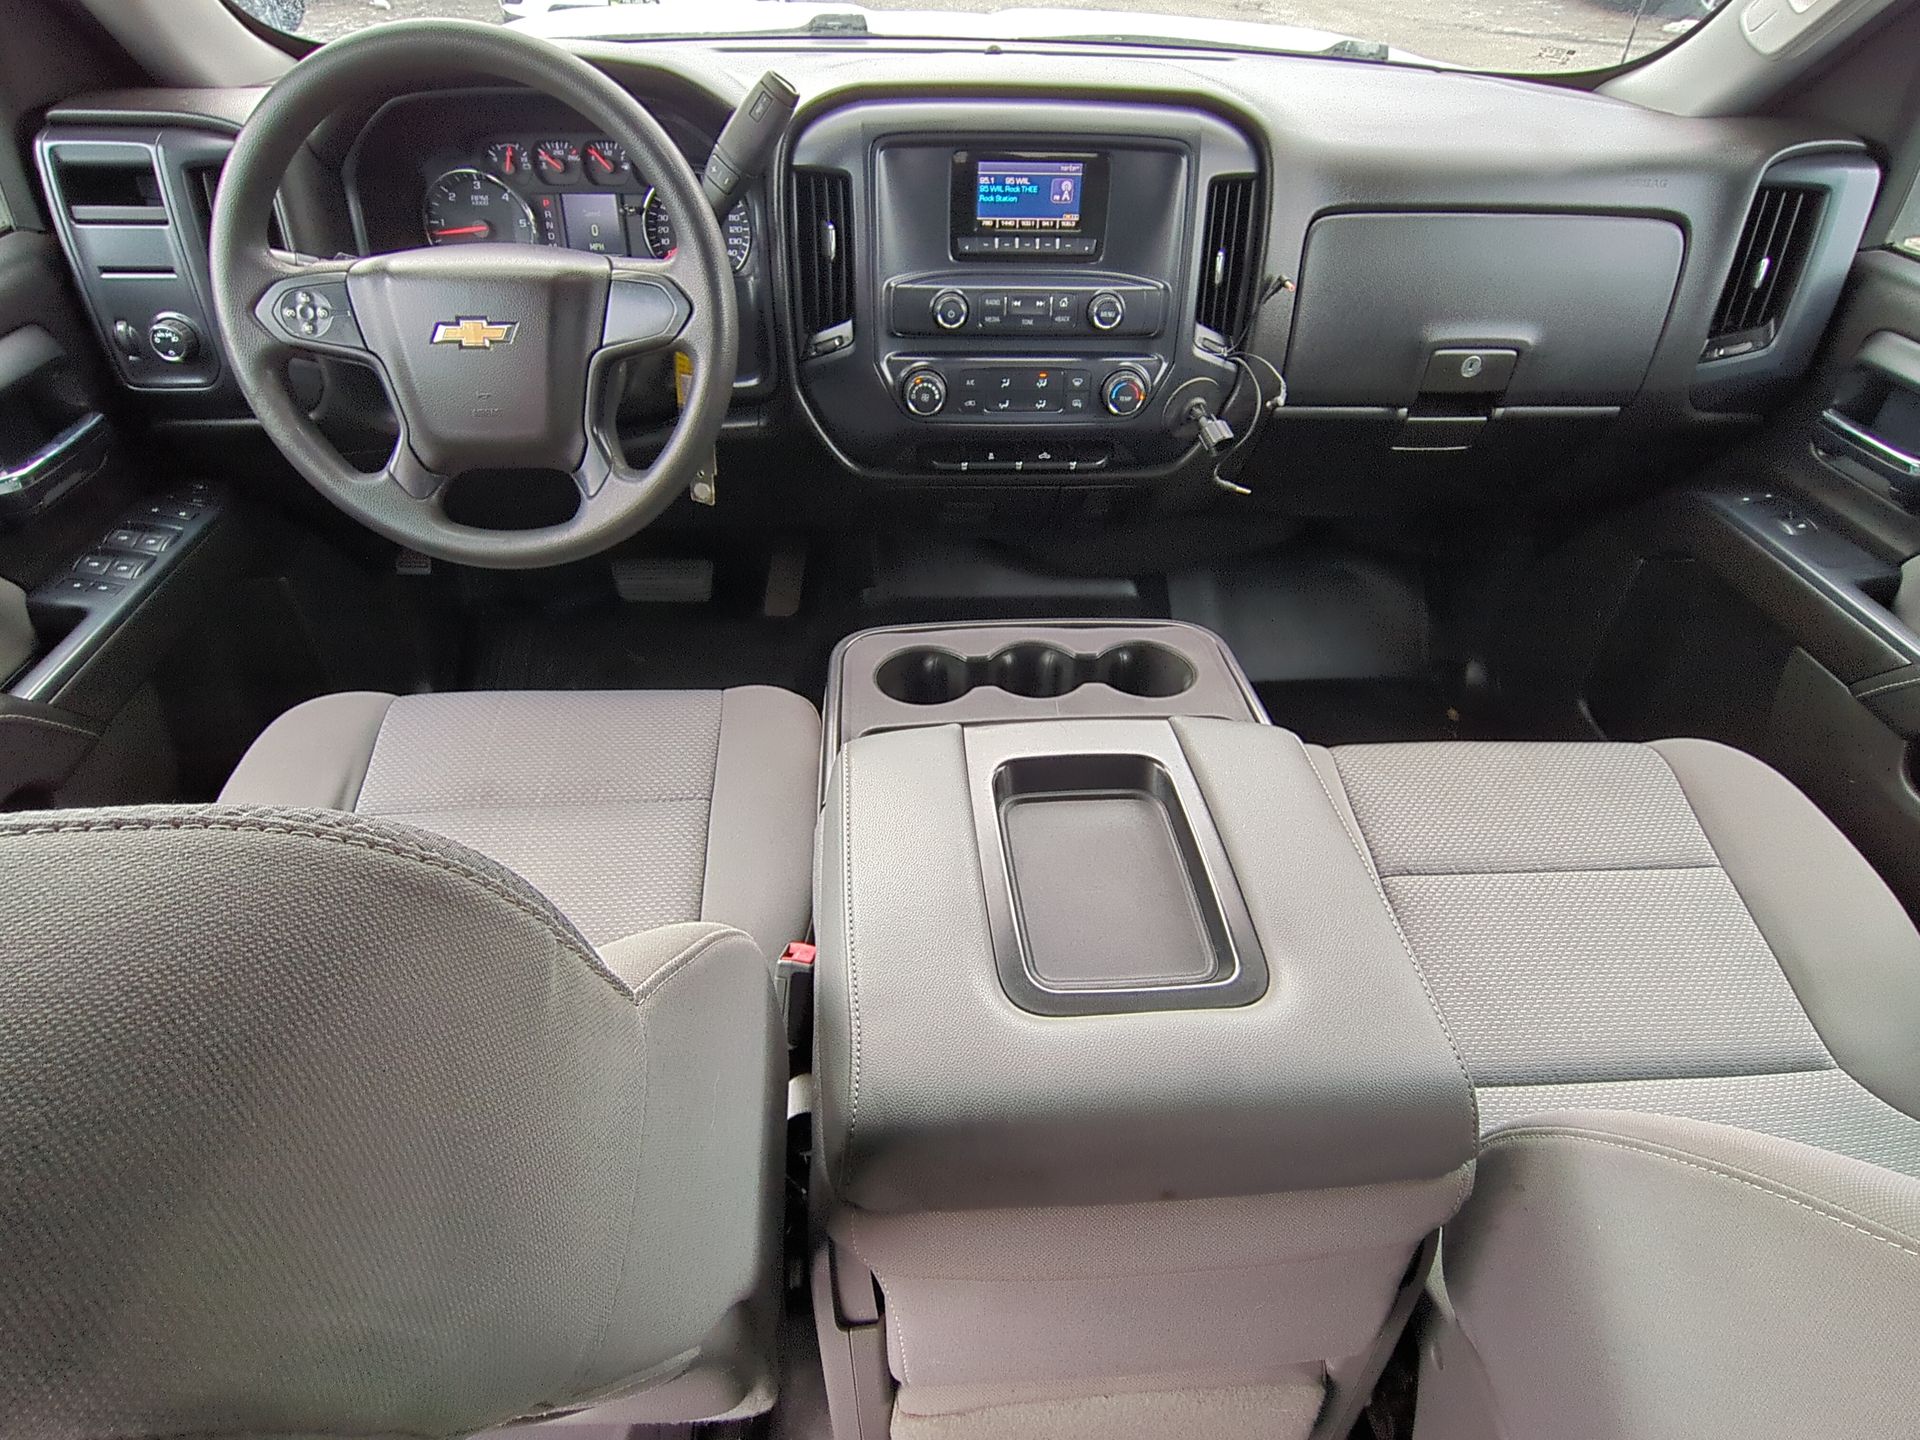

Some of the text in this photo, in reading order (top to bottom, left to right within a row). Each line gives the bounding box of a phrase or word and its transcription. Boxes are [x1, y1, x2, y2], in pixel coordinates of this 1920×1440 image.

[473, 181, 481, 190] 3
[1004, 185, 1021, 193] Rock
[449, 193, 456, 201] 2
[502, 193, 509, 201] 4
[995, 195, 1018, 203] Station
[519, 219, 527, 228] 5
[548, 232, 555, 240] D
